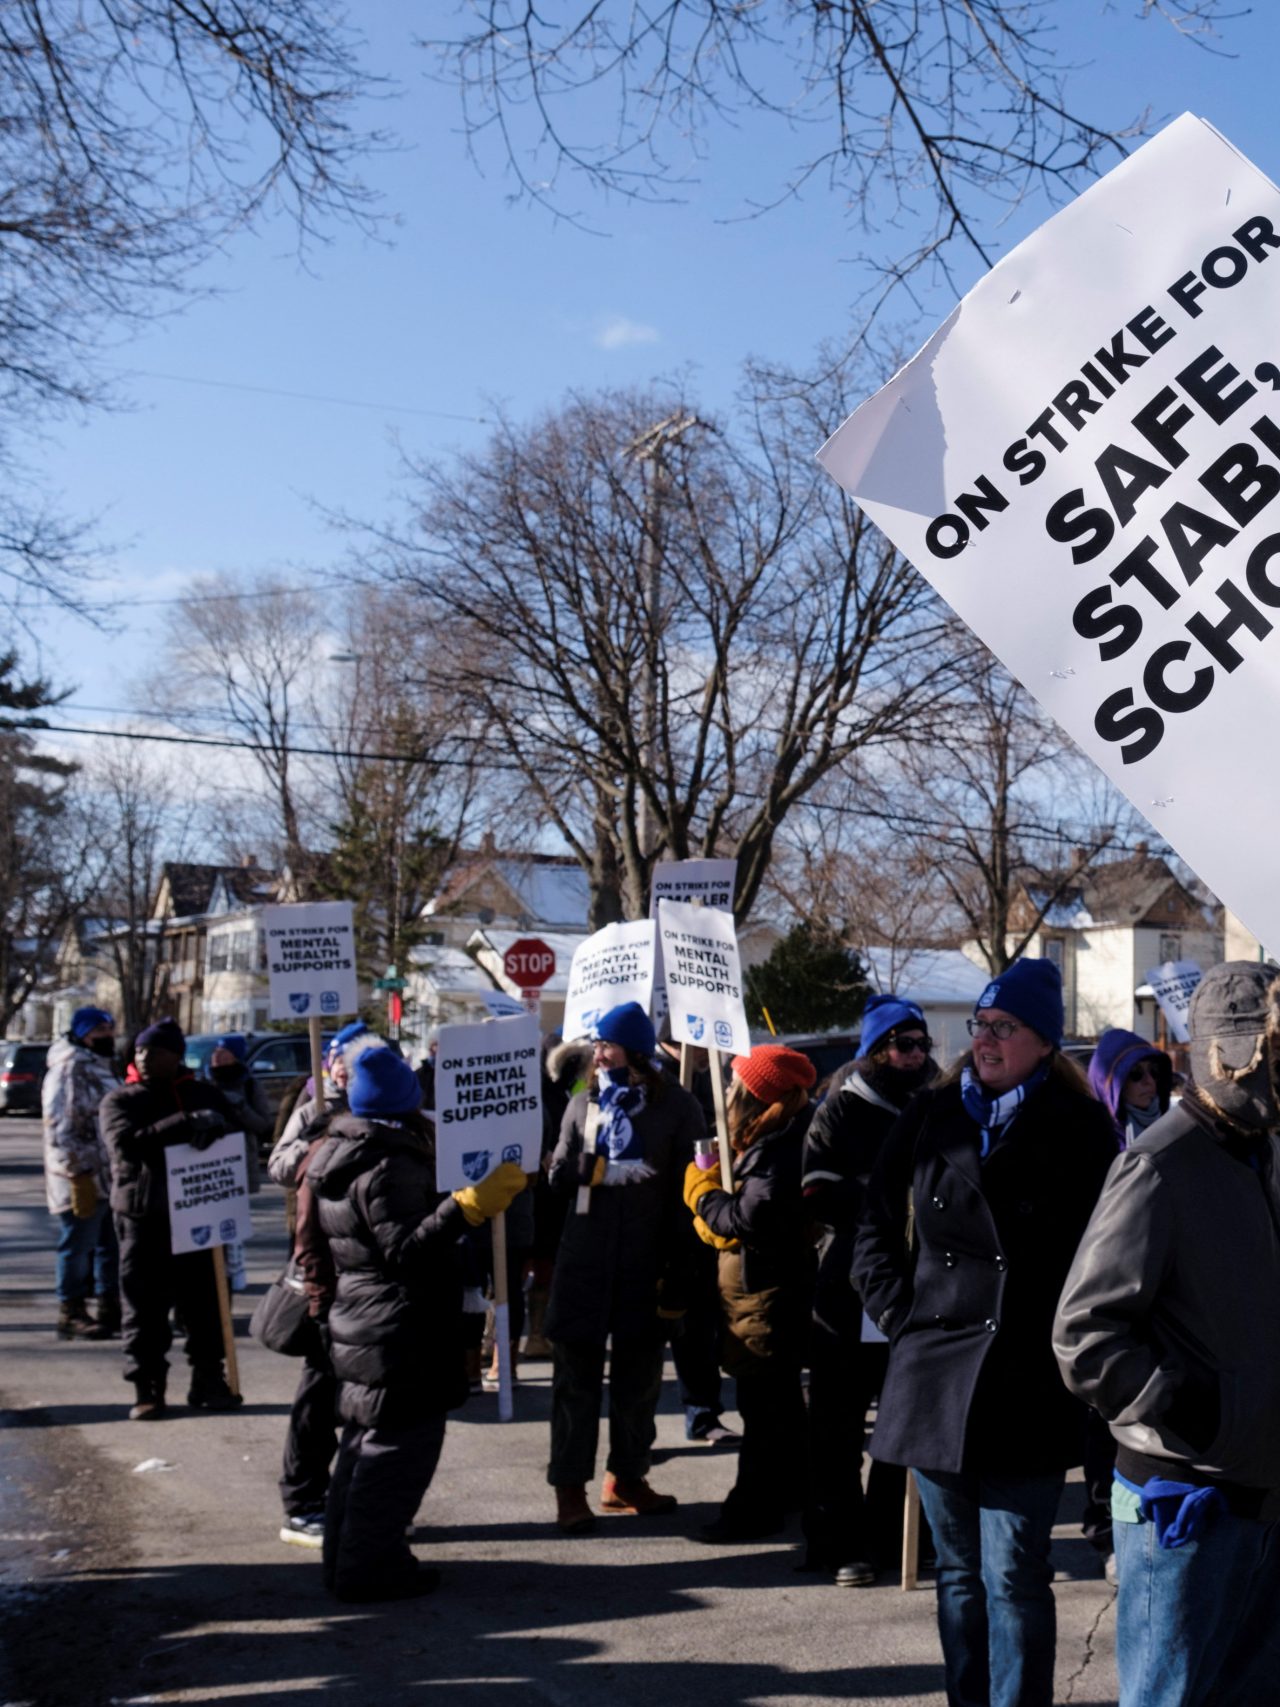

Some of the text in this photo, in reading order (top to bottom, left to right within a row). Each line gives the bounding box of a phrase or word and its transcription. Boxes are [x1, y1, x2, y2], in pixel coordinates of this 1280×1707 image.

[926, 475, 1009, 558] ON
[1003, 306, 1176, 487] STRIKE
[655, 880, 731, 891] ON STRIKE FOR
[269, 926, 349, 937] ON STRIKE FOR
[664, 929, 735, 952] ON STRIKE FOR
[280, 937, 340, 949] MENTAL
[272, 958, 352, 973] SUPPORTS
[282, 949, 340, 961] HEALTH
[506, 953, 554, 974] STOP
[582, 952, 641, 974] MENTAL
[674, 945, 729, 967] MENTAL
[582, 963, 638, 983] HEALTH
[677, 960, 730, 981] HEALTH
[571, 971, 649, 998] SUPPORTS
[669, 973, 740, 999] SUPPORTS
[442, 1048, 536, 1070] ON STRIKE FOR
[455, 1065, 527, 1088] MENTAL
[457, 1082, 526, 1105] HEALTH
[442, 1096, 539, 1124] SUPPORTS
[181, 1167, 235, 1186] MENTAL
[184, 1178, 235, 1197] HEALTH
[174, 1185, 245, 1211] SUPPORTS
